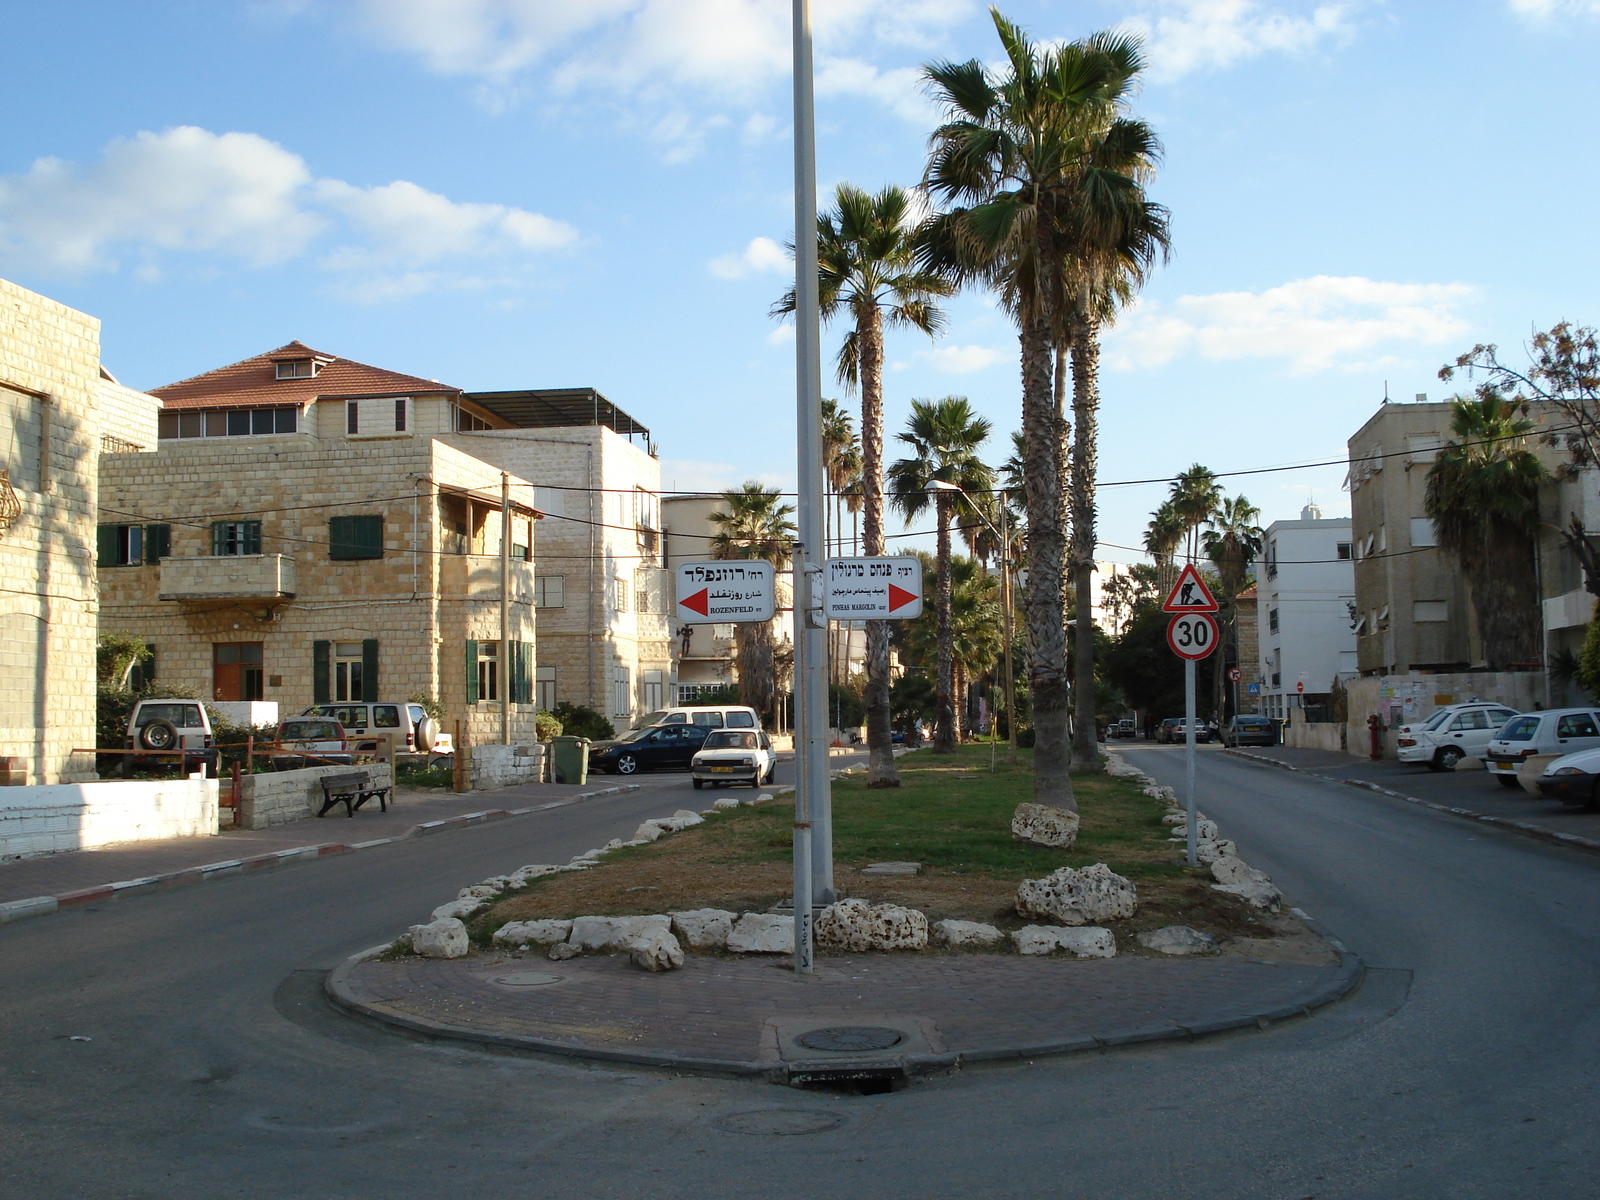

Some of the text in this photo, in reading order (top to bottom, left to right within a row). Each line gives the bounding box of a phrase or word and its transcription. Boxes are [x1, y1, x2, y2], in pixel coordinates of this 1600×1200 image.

[684, 566, 745, 583] רוזנפלד
[831, 561, 865, 582] מרגולין
[710, 606, 754, 614] ROZENFELD
[851, 603, 876, 611] MARGOLIN
[1178, 621, 1208, 647] 30
